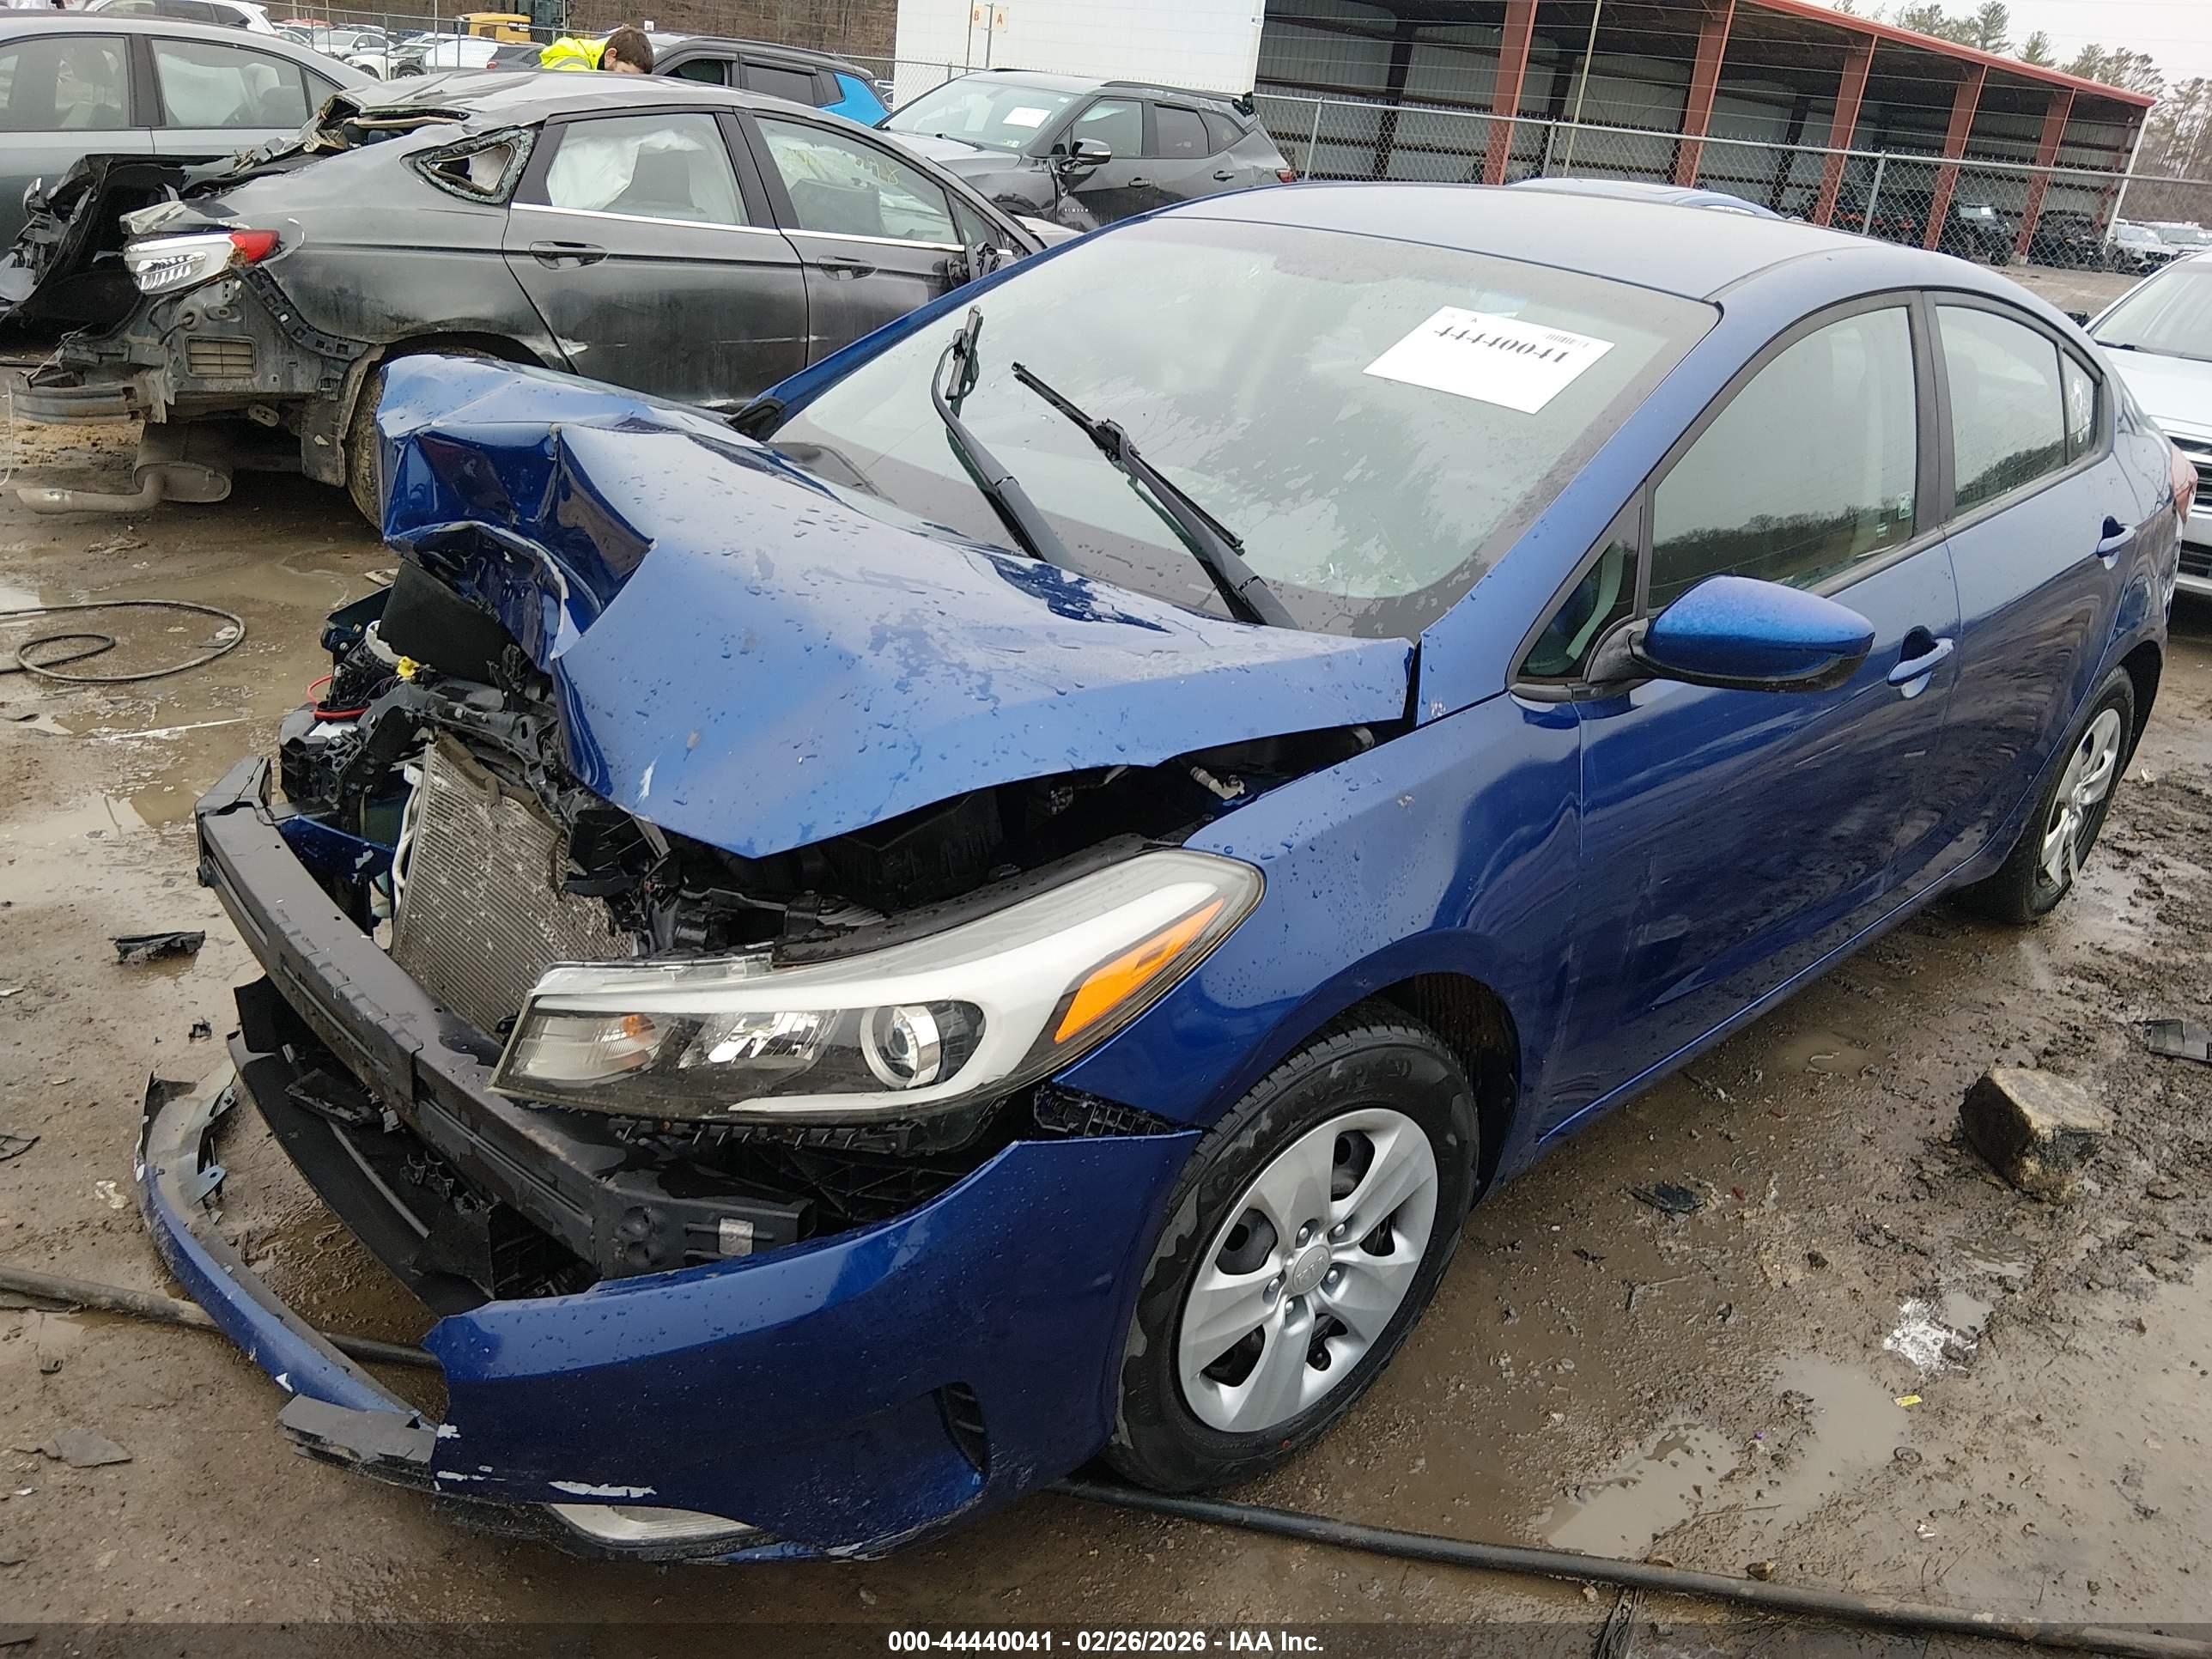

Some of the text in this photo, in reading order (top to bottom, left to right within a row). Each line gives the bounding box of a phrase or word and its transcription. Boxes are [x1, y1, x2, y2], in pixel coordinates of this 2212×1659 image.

[974, 9, 980, 21] B
[997, 13, 1003, 25] A
[1434, 325, 1569, 362] 44440041
